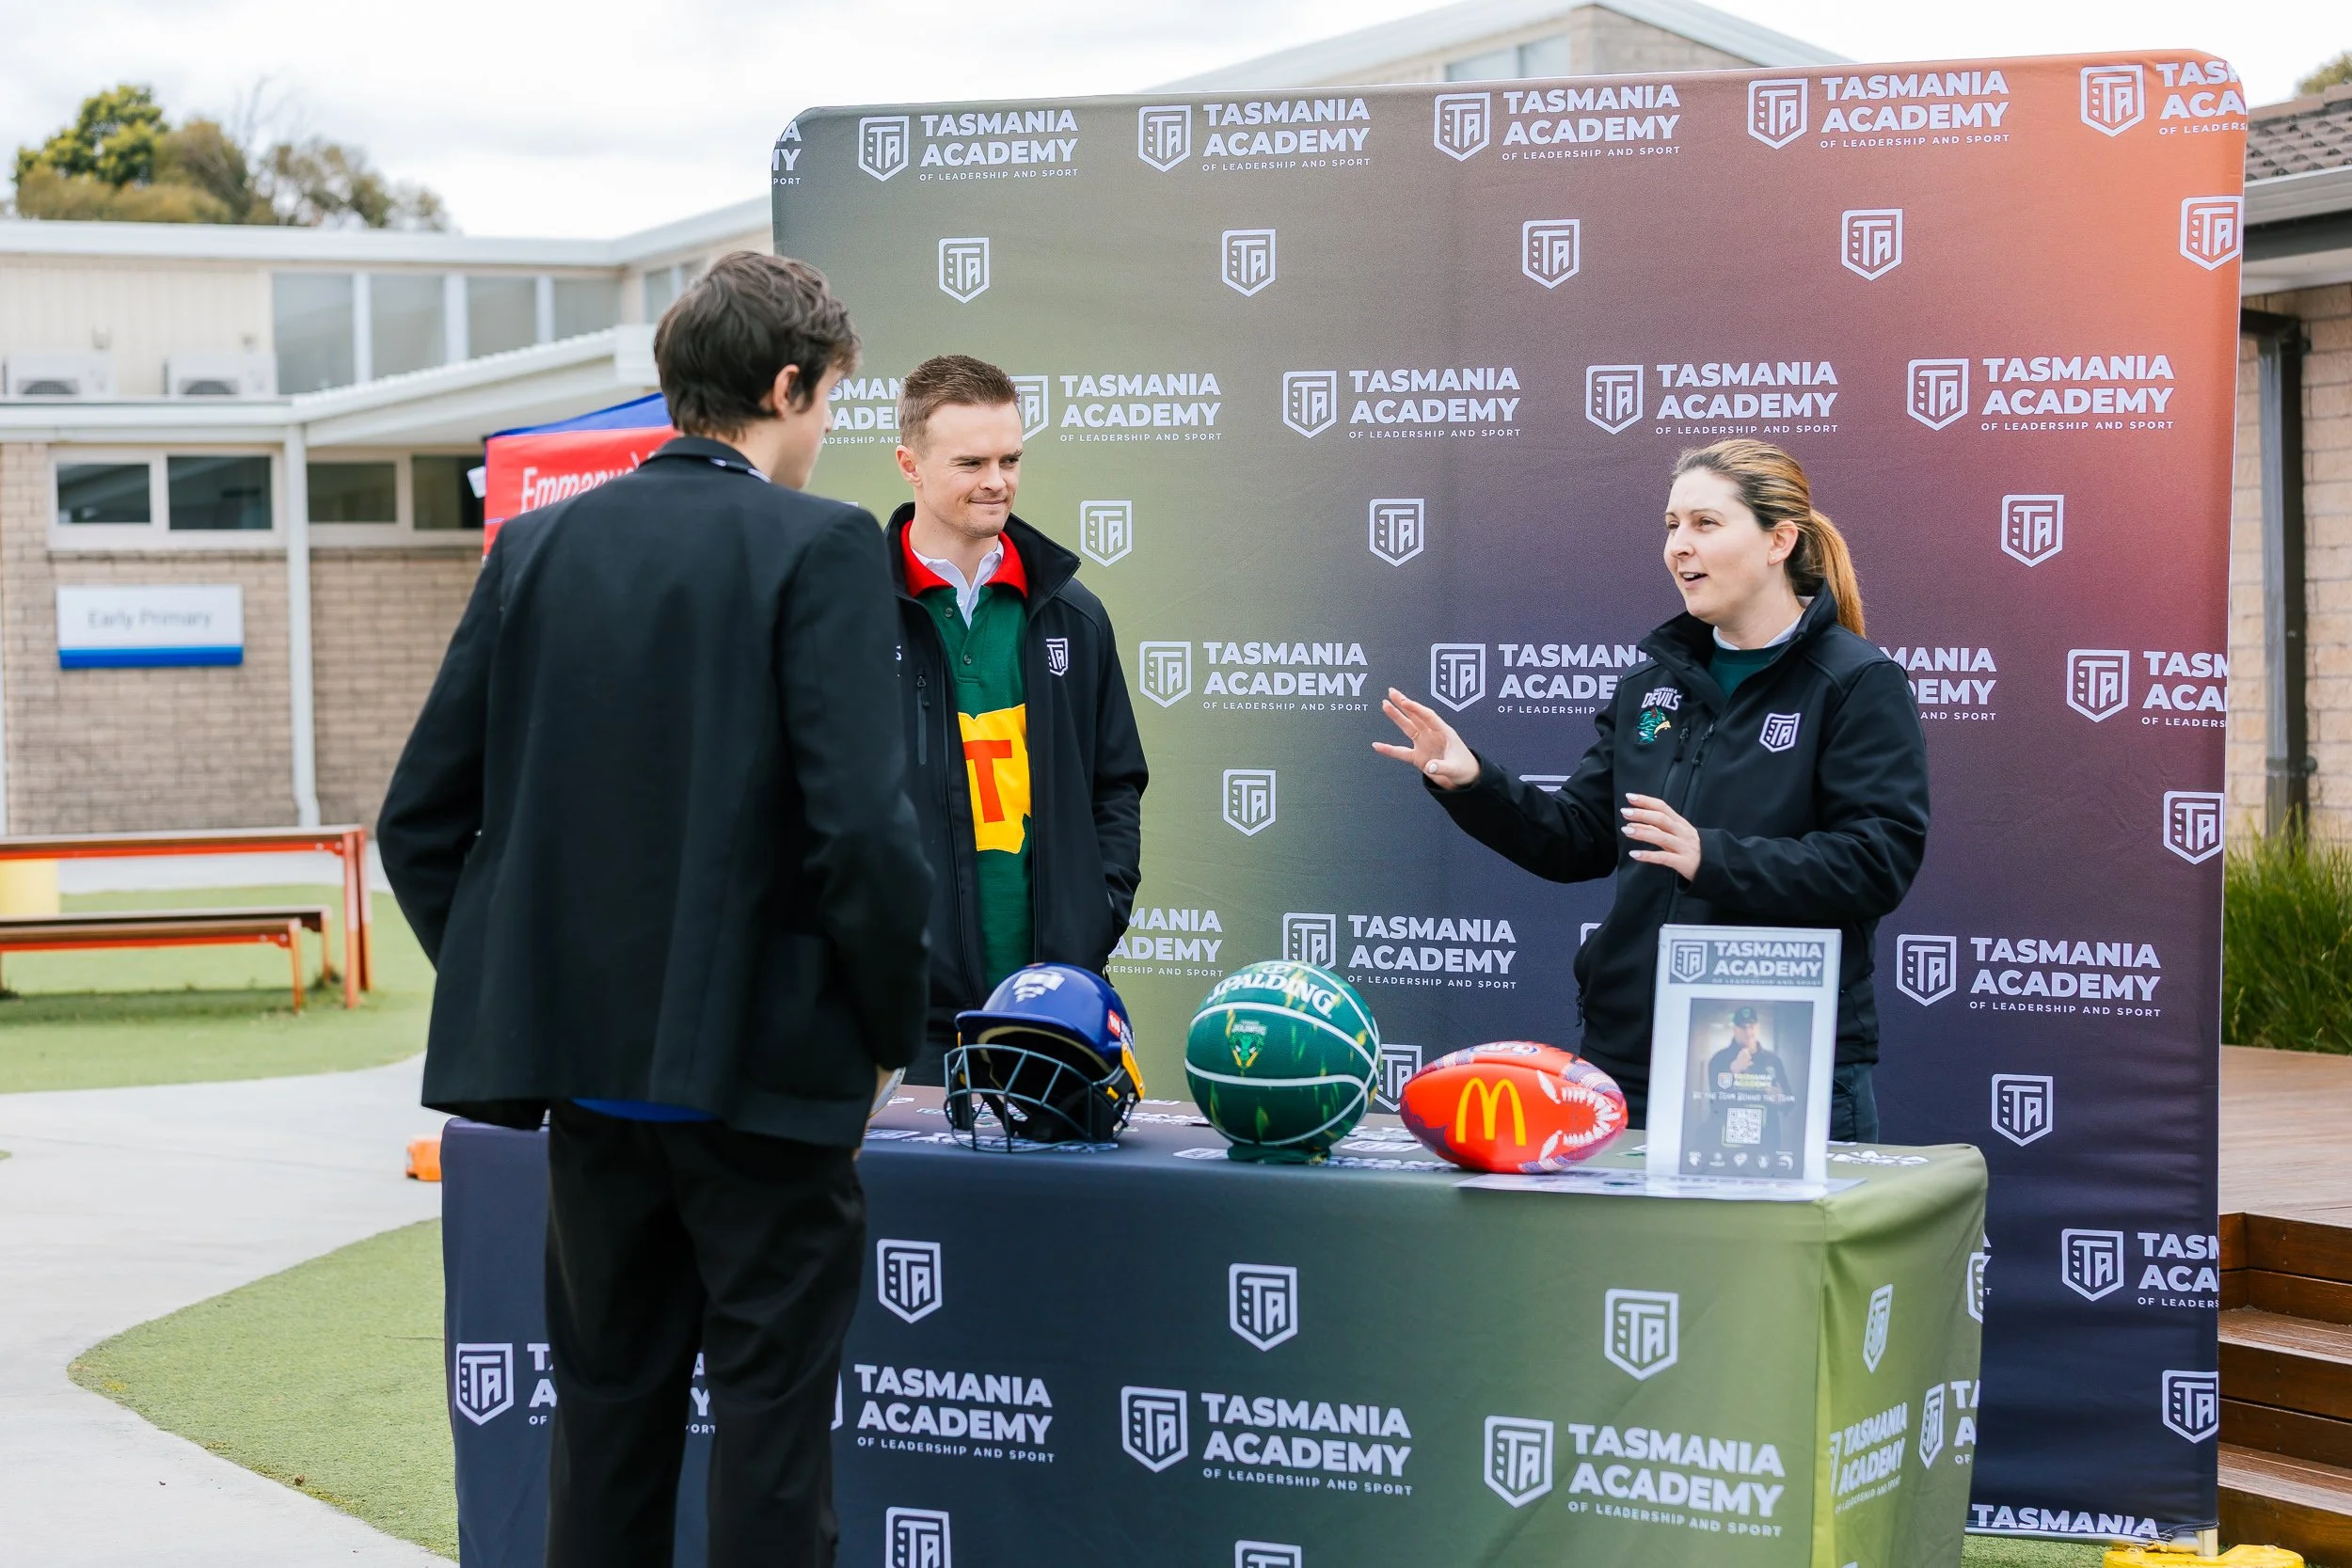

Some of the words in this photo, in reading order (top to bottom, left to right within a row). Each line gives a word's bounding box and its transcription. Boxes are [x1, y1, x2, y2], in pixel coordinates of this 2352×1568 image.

[1503, 85, 1680, 114] TASMANIA
[1821, 71, 2010, 101] TASMANIA
[921, 109, 1078, 136] TASMANIA
[1203, 98, 1371, 126] TASMANIA
[1820, 102, 2009, 133] ACADEMY
[1202, 127, 1371, 157] ACADEMY
[1502, 115, 1680, 146] ACADEMY
[1843, 137, 1926, 147] LEADERSHIP
[1966, 135, 2010, 143] SPORT
[2159, 127, 2177, 135] OF
[920, 138, 1078, 166] ACADEMY
[1223, 161, 1295, 170] LEADERSHIP
[1332, 158, 1370, 166] SPORT
[1502, 152, 1518, 161] OF
[1523, 150, 1601, 160] LEADERSHIP
[1607, 148, 1633, 156] AND
[1640, 146, 1680, 155] SPORT
[939, 171, 1009, 181] LEADERSHIP
[1041, 168, 1078, 177] SPORT
[1349, 367, 1520, 393] TASMANIA
[1656, 361, 1838, 388] TASMANIA
[1982, 355, 2174, 382] TASMANIA
[1059, 373, 1221, 398] TASMANIA
[1349, 398, 1520, 424] ACADEMY
[1656, 392, 1838, 420] ACADEMY
[1981, 388, 2174, 415] ACADEMY
[832, 406, 900, 431] ADE
[1060, 403, 1221, 428] ACADEMY
[1796, 424, 1837, 433] SPORT
[1981, 422, 1997, 431] OF
[2005, 421, 2089, 430] LEADERSHIP
[880, 436, 901, 444] AND
[1370, 430, 1444, 438] LEADERSHIP
[87, 608, 134, 632] Early
[140, 607, 213, 632] Primary
[1202, 641, 1368, 665] TASMANIA
[1203, 671, 1368, 696] ACADEMY
[1498, 674, 1620, 700] ACADE
[1908, 679, 1996, 705] EMY
[1203, 701, 1217, 709] OF
[1223, 702, 1295, 710] LEADERSHIP
[1641, 691, 1682, 711] DEVILS
[1954, 712, 1996, 721] SPORT
[2141, 717, 2159, 725] OF
[963, 739, 1012, 823] T
[1347, 914, 1517, 943] TASMANIA
[1348, 944, 1517, 974] ACADEMY
[1713, 942, 1823, 958] TASMANIA
[1970, 937, 2161, 969] TASMANIA
[1158, 967, 1182, 975] AND
[1186, 969, 1223, 977] SPORT
[1713, 958, 1822, 977] ACADEMY
[1206, 973, 1337, 1019] SPALDING
[1368, 976, 1441, 986] LEADERSHIP
[1448, 979, 1472, 988] AND
[1478, 980, 1517, 989] SPORT
[1970, 969, 2161, 1001] ACADEMY
[1969, 1001, 1986, 1009] OF
[1993, 1002, 2076, 1013] LEADERSHIP
[2082, 1006, 2110, 1015] AND
[2117, 1007, 2161, 1017] SPORT
[2137, 1296, 2155, 1306] OF
[854, 1364, 1053, 1408] TASMANIA
[857, 1401, 1053, 1445] ACADEMY
[1201, 1392, 1412, 1439] TASMANIA
[1844, 1402, 1908, 1457] TASMANIA
[857, 1436, 874, 1447] OF
[881, 1439, 967, 1455] LEADERSHIP
[974, 1447, 1003, 1458] AND
[1009, 1449, 1054, 1463] SPORT
[1203, 1431, 1412, 1477] ACADEMY
[1568, 1423, 1786, 1478] TASMANIA
[1837, 1437, 1906, 1497] ACADEMY
[1203, 1468, 1220, 1478] OF
[1229, 1470, 1320, 1487] LEADERSHIP
[1327, 1479, 1358, 1491] AND
[1364, 1481, 1412, 1496] SPORT
[1568, 1463, 1785, 1518] ACADEMY
[1568, 1501, 1588, 1513] OF
[1596, 1503, 1685, 1526] LEADERSHIP
[1689, 1517, 1721, 1532] AND
[1727, 1522, 1783, 1538] SPORT
[1972, 1504, 2160, 1538] TASMANIA
